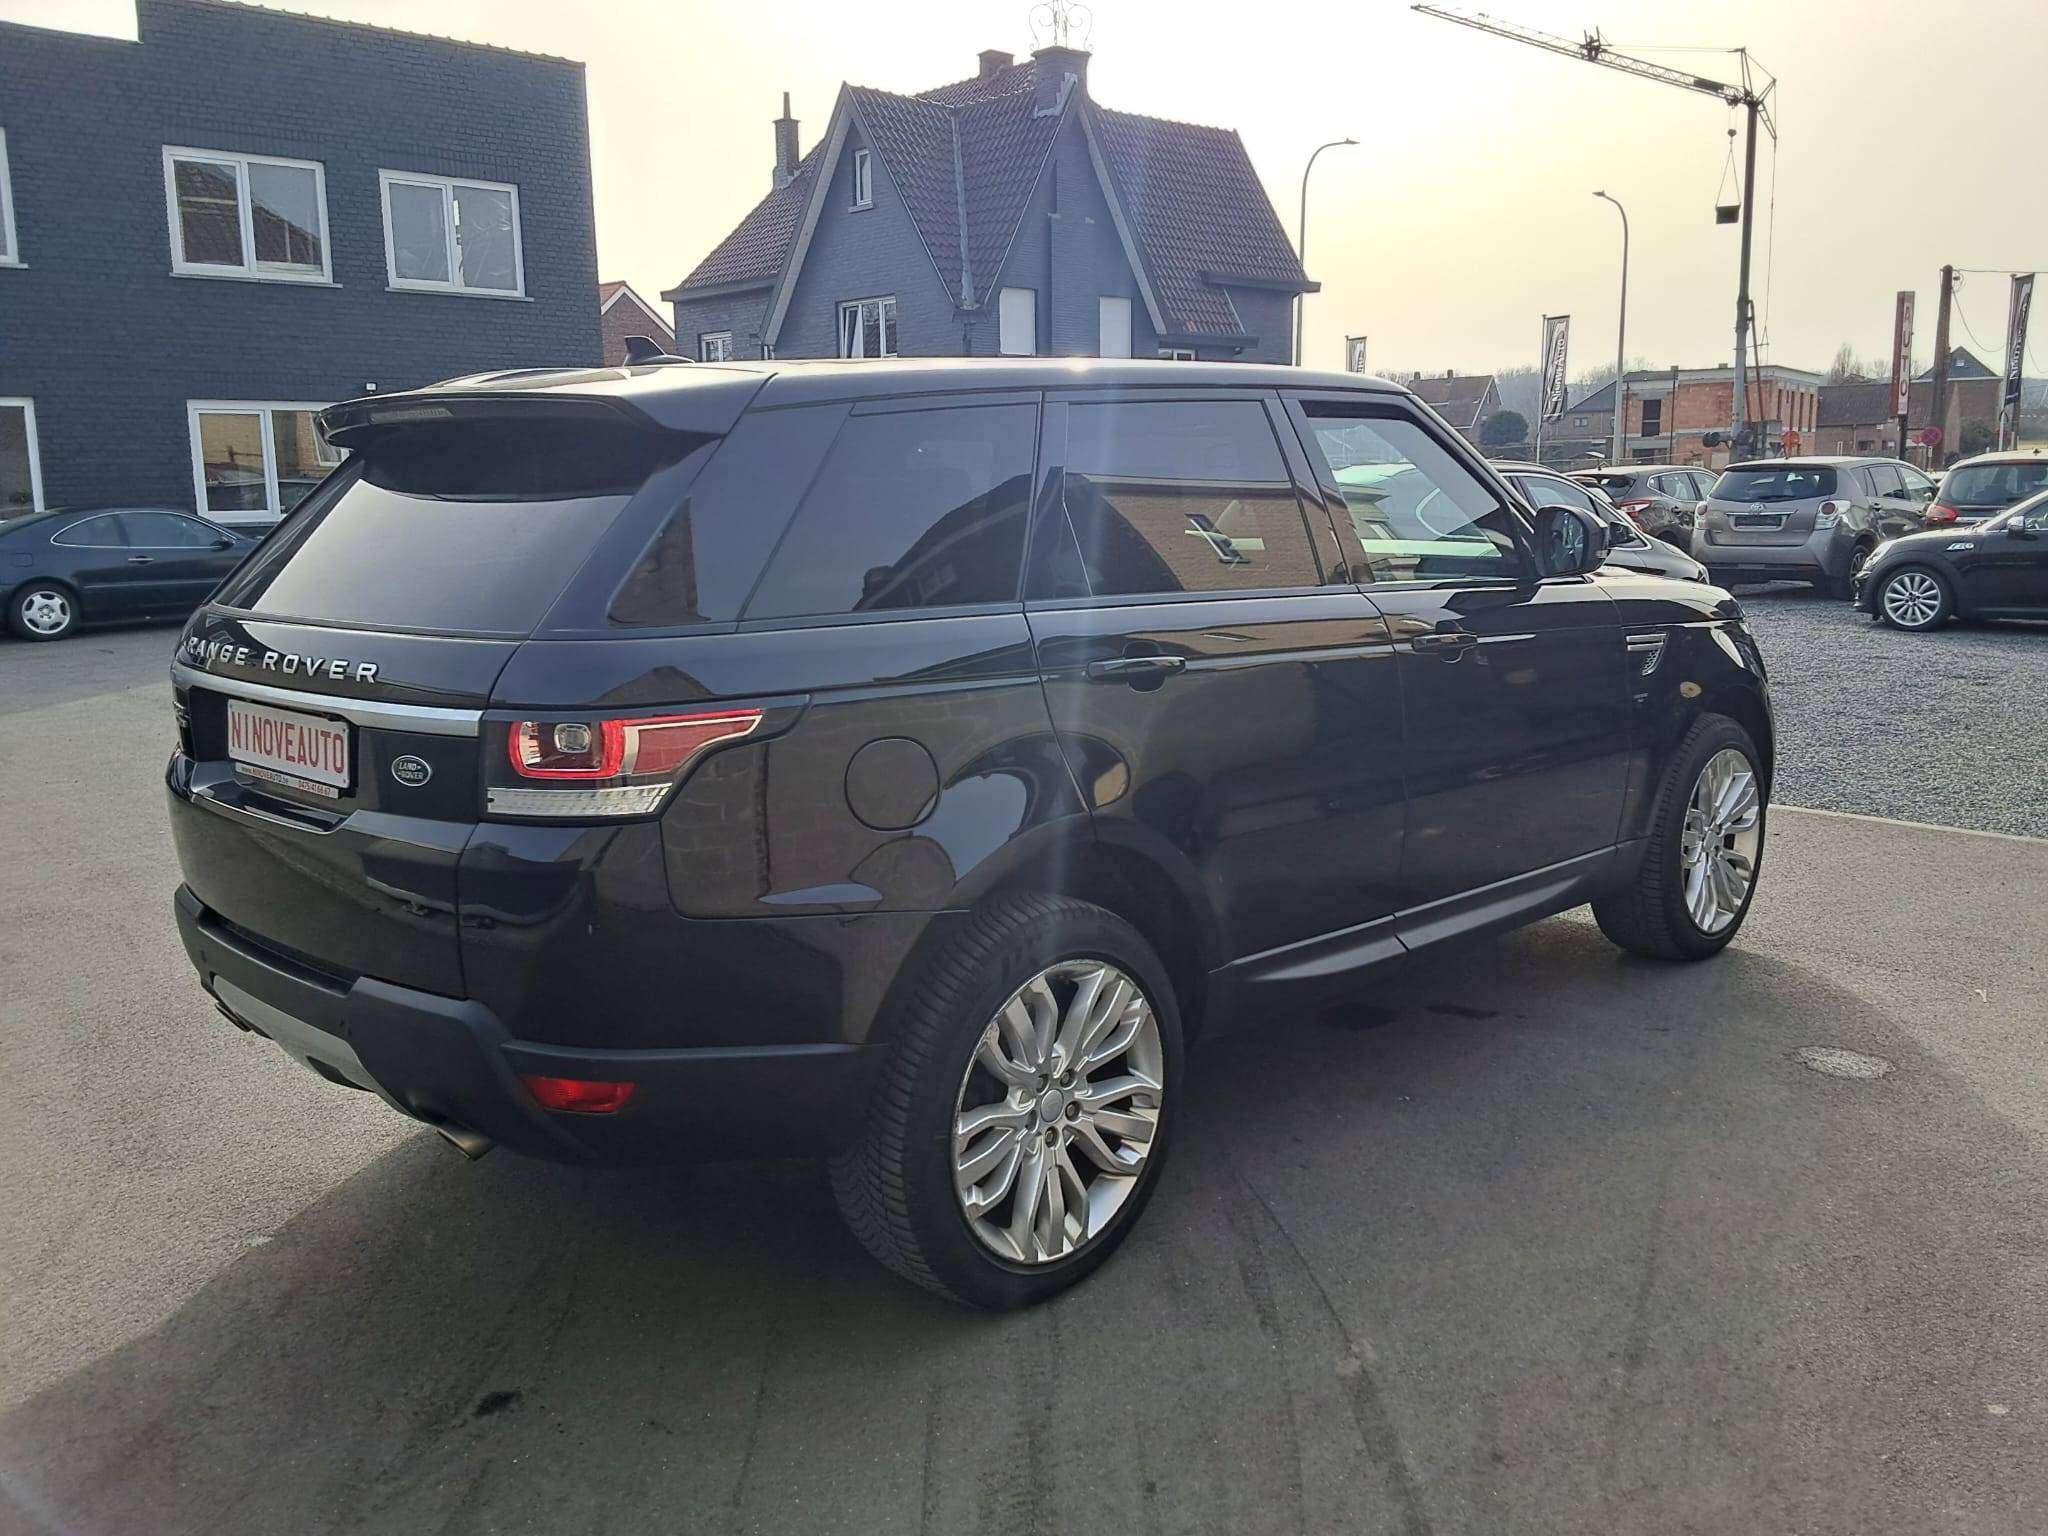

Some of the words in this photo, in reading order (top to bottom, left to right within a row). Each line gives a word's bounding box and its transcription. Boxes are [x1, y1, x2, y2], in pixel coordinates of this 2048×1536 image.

[1900, 305, 1911, 396] AUTO
[187, 637, 250, 666] RANGE
[262, 651, 379, 684] ROVER
[231, 711, 345, 774] NINOVEAUTO
